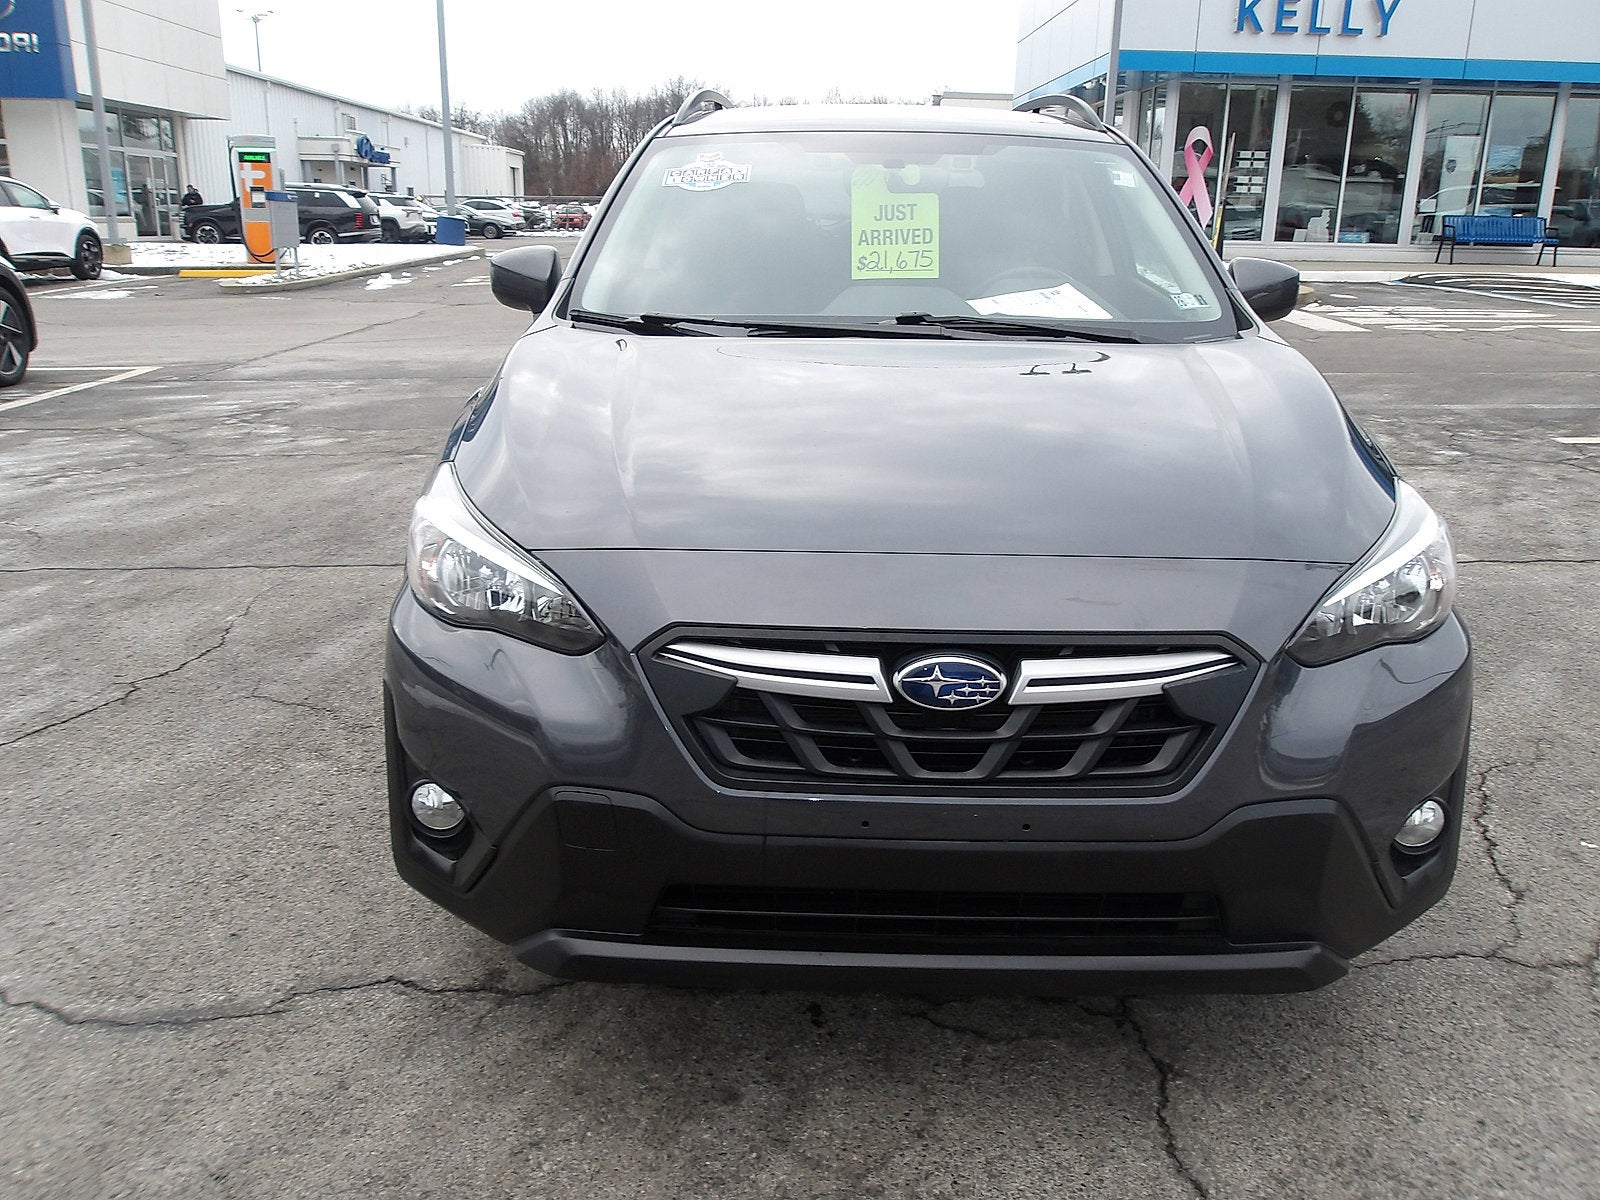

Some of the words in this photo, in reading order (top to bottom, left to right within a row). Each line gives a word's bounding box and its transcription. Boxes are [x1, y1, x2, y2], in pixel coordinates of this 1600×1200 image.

[1234, 0, 1400, 37] KELLY
[873, 203, 918, 222] JUST
[858, 228, 934, 246] ARRIVED
[857, 249, 934, 274] $21,675
